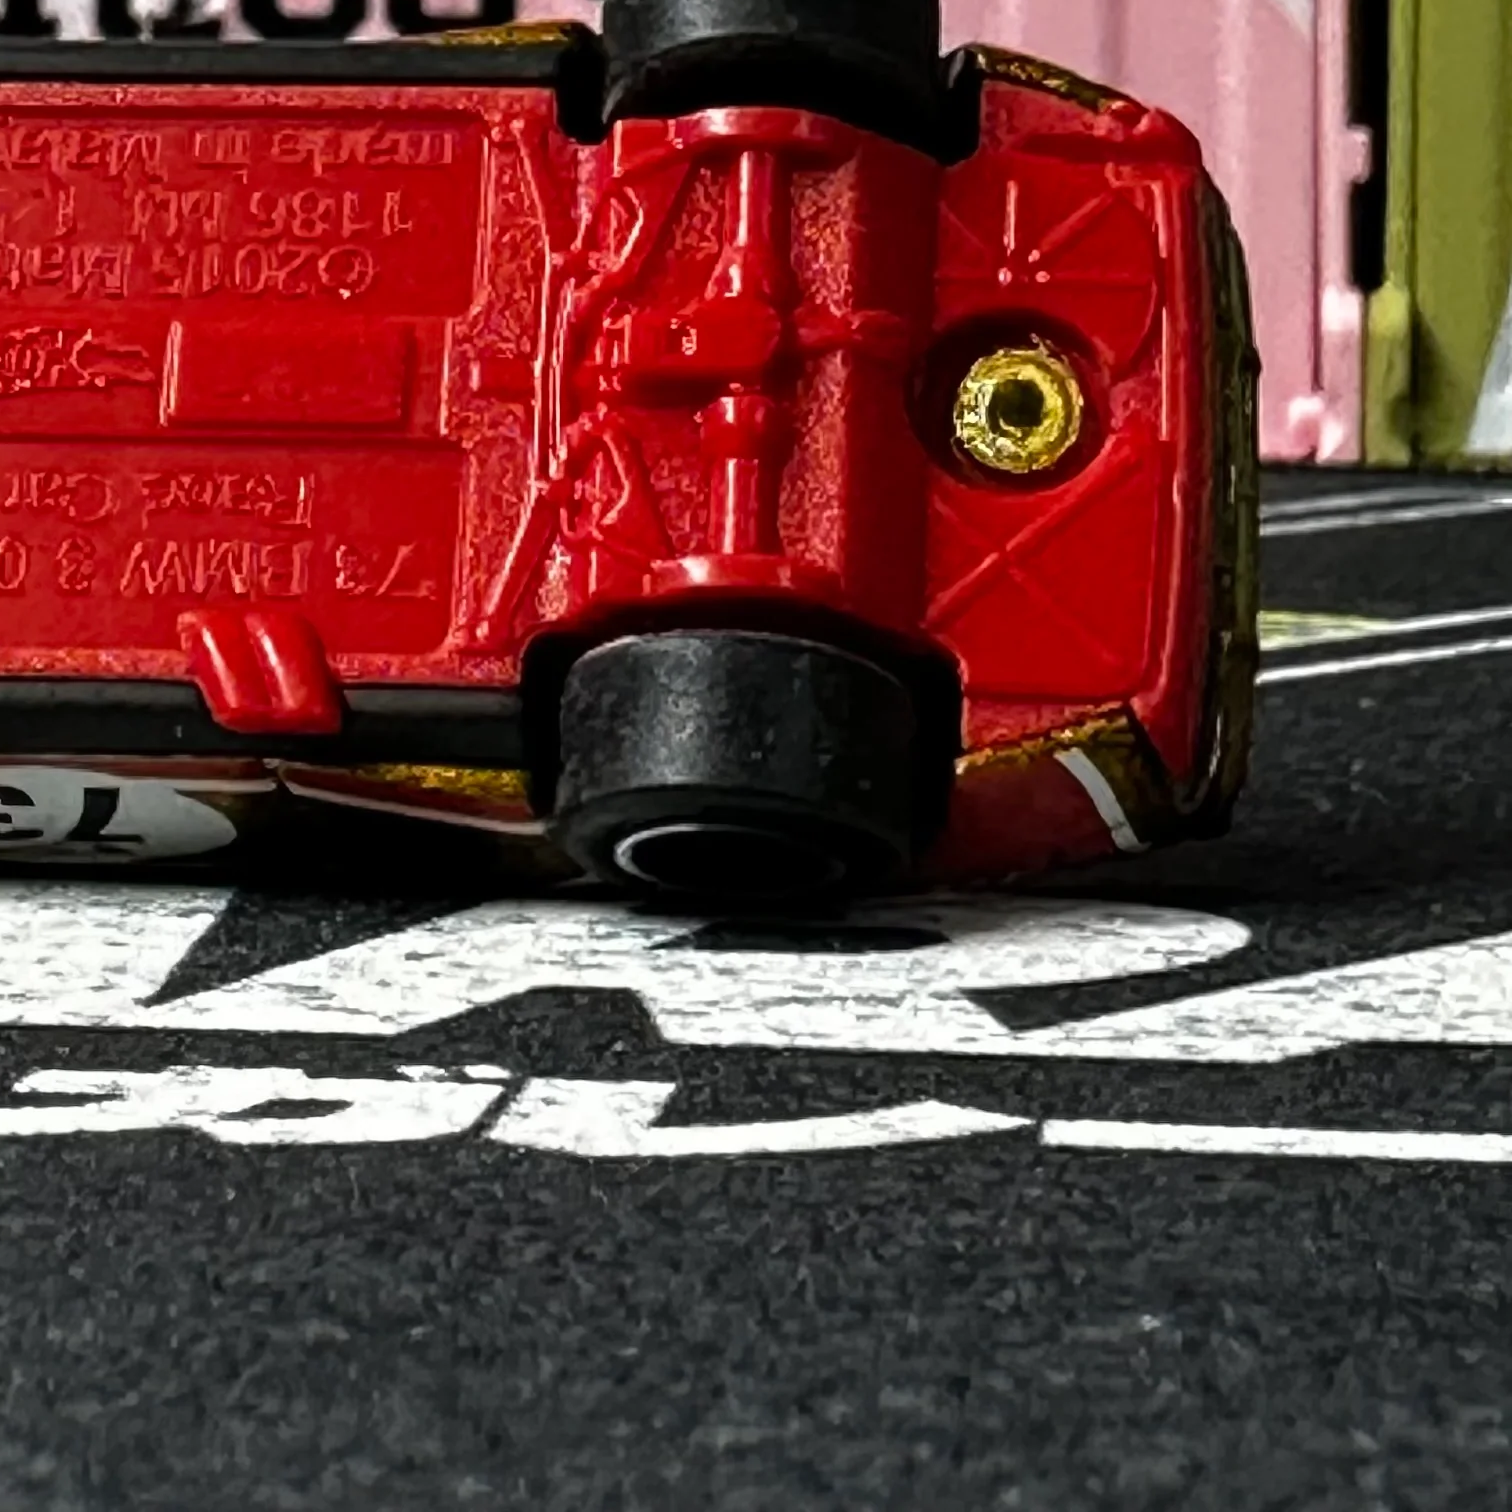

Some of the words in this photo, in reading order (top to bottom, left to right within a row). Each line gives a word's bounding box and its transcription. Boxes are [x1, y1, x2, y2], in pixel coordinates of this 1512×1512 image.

[193, 129, 250, 183] in
[249, 189, 413, 238] 1186
[3, 471, 115, 524] Car
[119, 538, 309, 600] BMW
